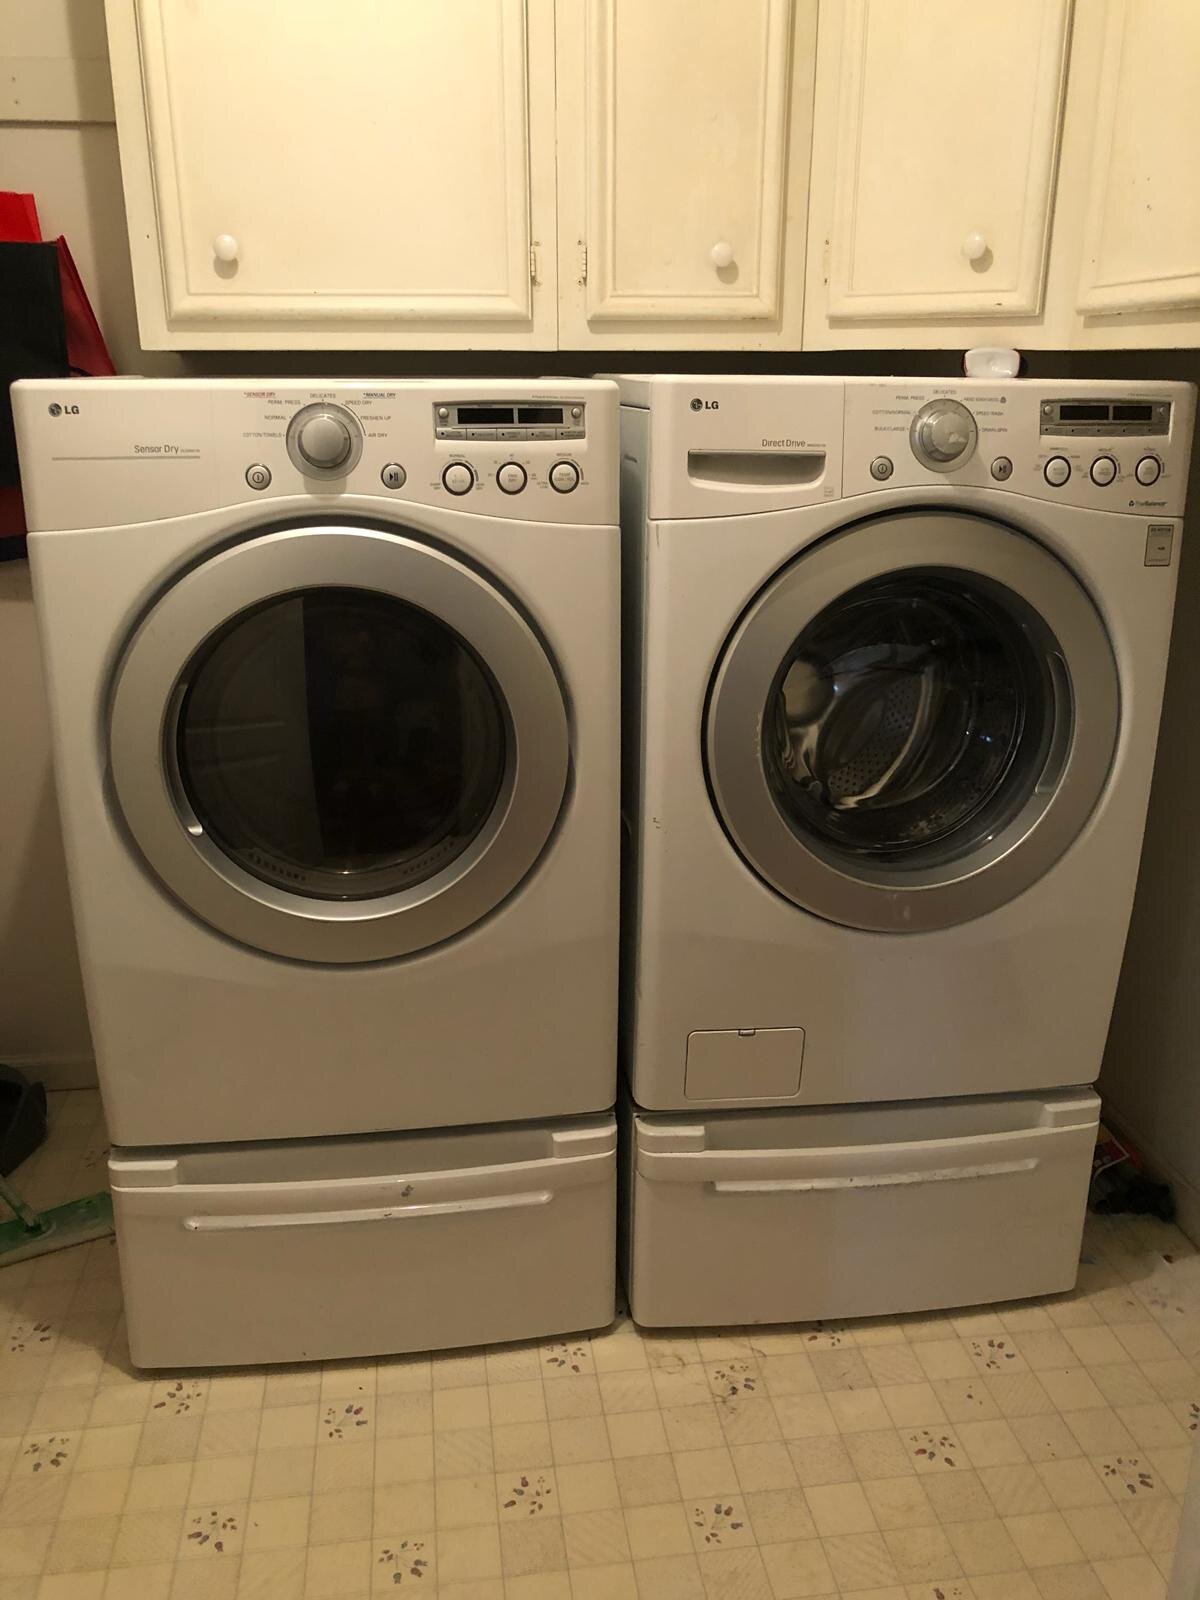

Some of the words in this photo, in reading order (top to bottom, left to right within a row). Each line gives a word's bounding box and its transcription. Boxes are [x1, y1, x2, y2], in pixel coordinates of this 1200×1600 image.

[64, 405, 80, 415] LG
[704, 400, 720, 410] LG
[761, 438, 785, 448] Direct
[785, 438, 806, 448] Drive
[134, 444, 163, 454] Sensor
[163, 444, 180, 455] Dry
